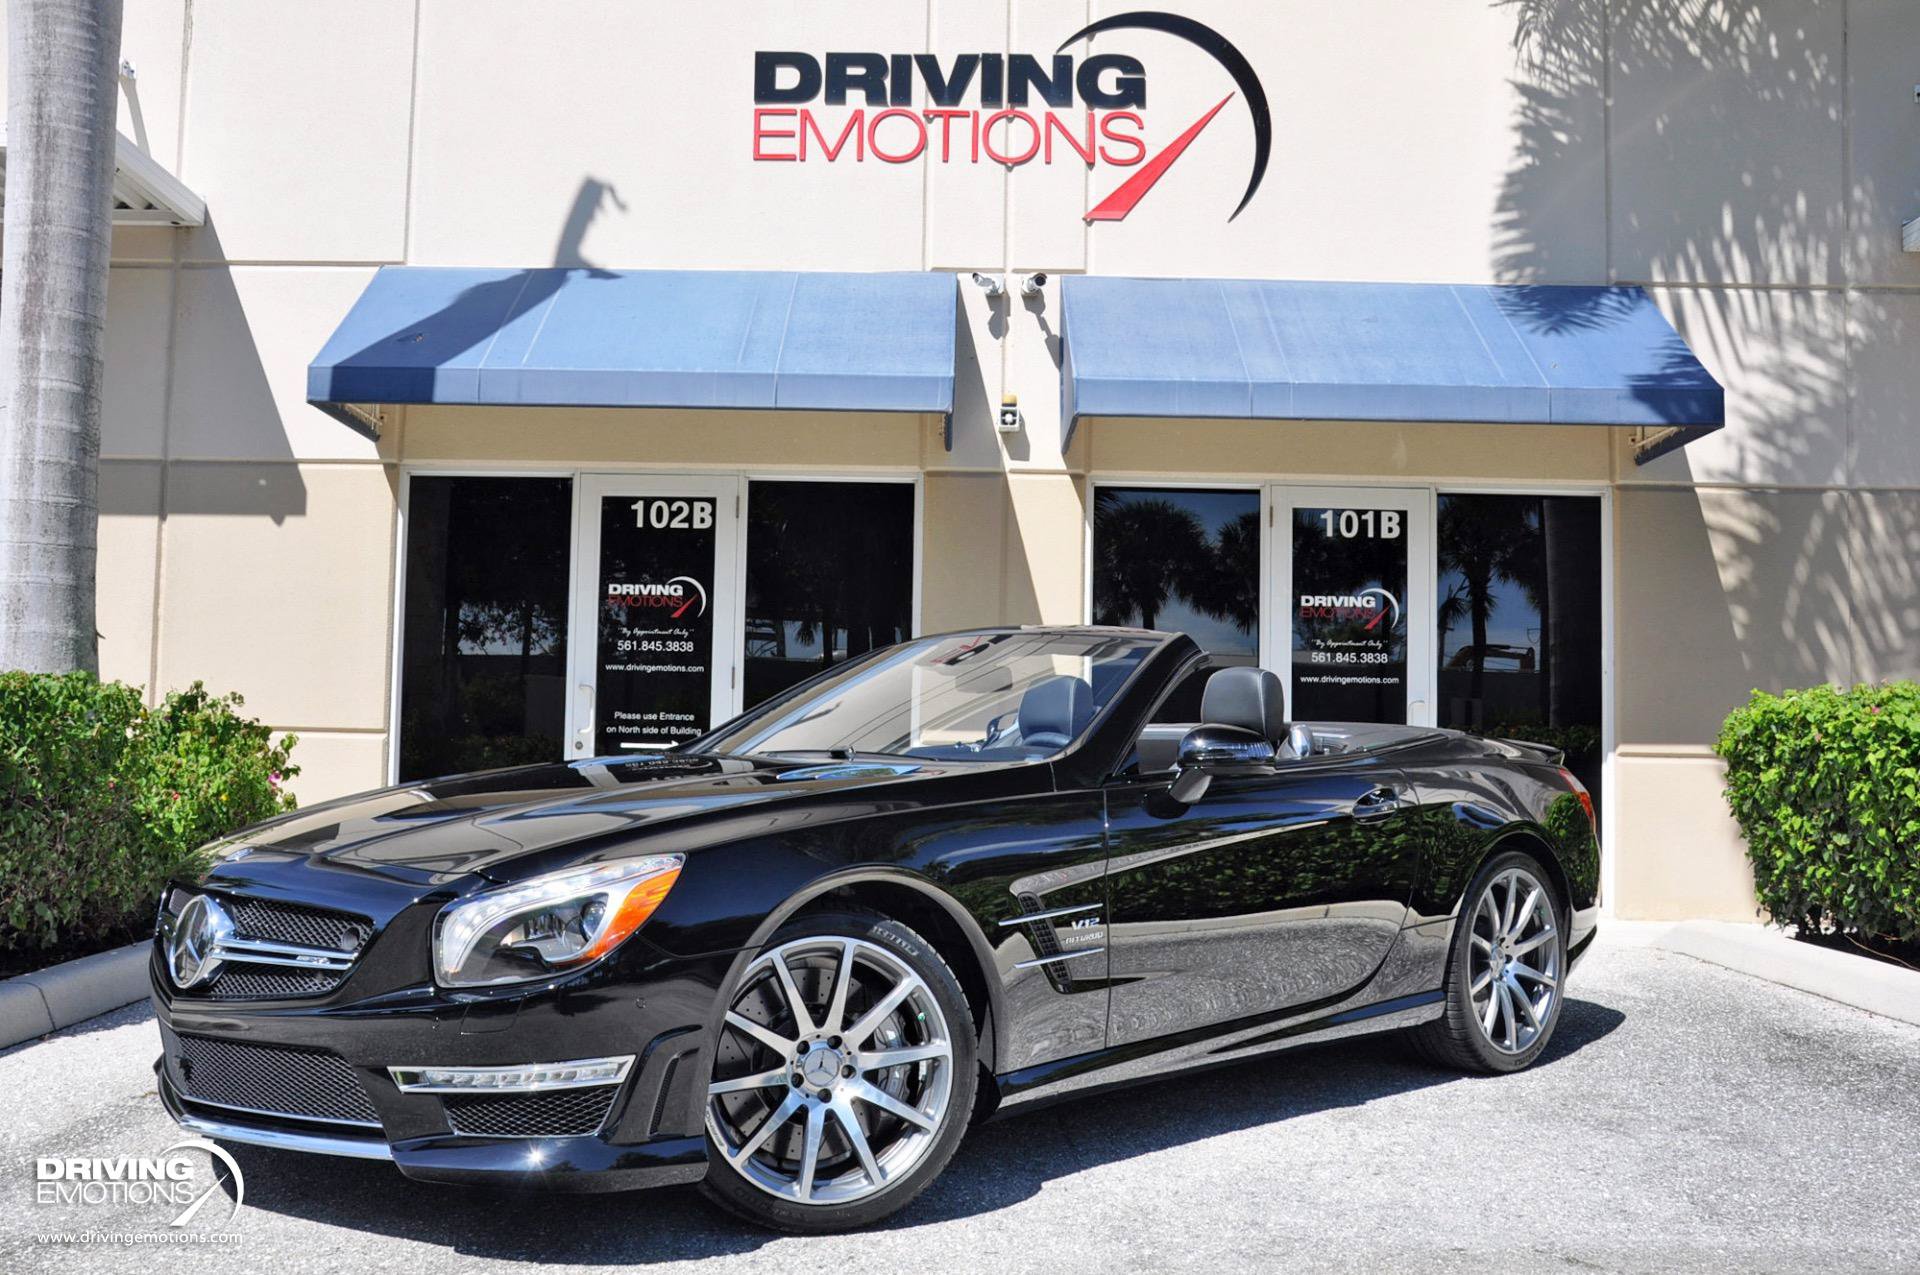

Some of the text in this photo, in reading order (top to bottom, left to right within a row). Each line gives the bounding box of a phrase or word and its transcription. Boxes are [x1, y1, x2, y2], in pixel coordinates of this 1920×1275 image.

[754, 51, 1147, 109] DRIVING
[752, 108, 1147, 167] EMOTIONS
[630, 500, 713, 529] 102B
[1320, 510, 1401, 539] 101B
[608, 583, 684, 596] DRIVING
[607, 595, 684, 608] EMOTIONS
[1301, 595, 1376, 608] DRIVING
[1301, 607, 1375, 619] EMOTIONS
[633, 627, 673, 637] Appointment
[617, 640, 695, 652] 561.845.3838
[1326, 639, 1366, 648] Appointment
[1311, 652, 1389, 664] 561.845.3838
[605, 663, 705, 673] www.drivingemotions.com
[1300, 676, 1400, 685] www.drivingemotions.com
[614, 711, 641, 720] Please
[659, 712, 695, 721] Entrance
[618, 725, 641, 734] North
[642, 726, 659, 735] side
[660, 726, 669, 735] of
[670, 726, 702, 738] Building
[1071, 917, 1100, 930] V12
